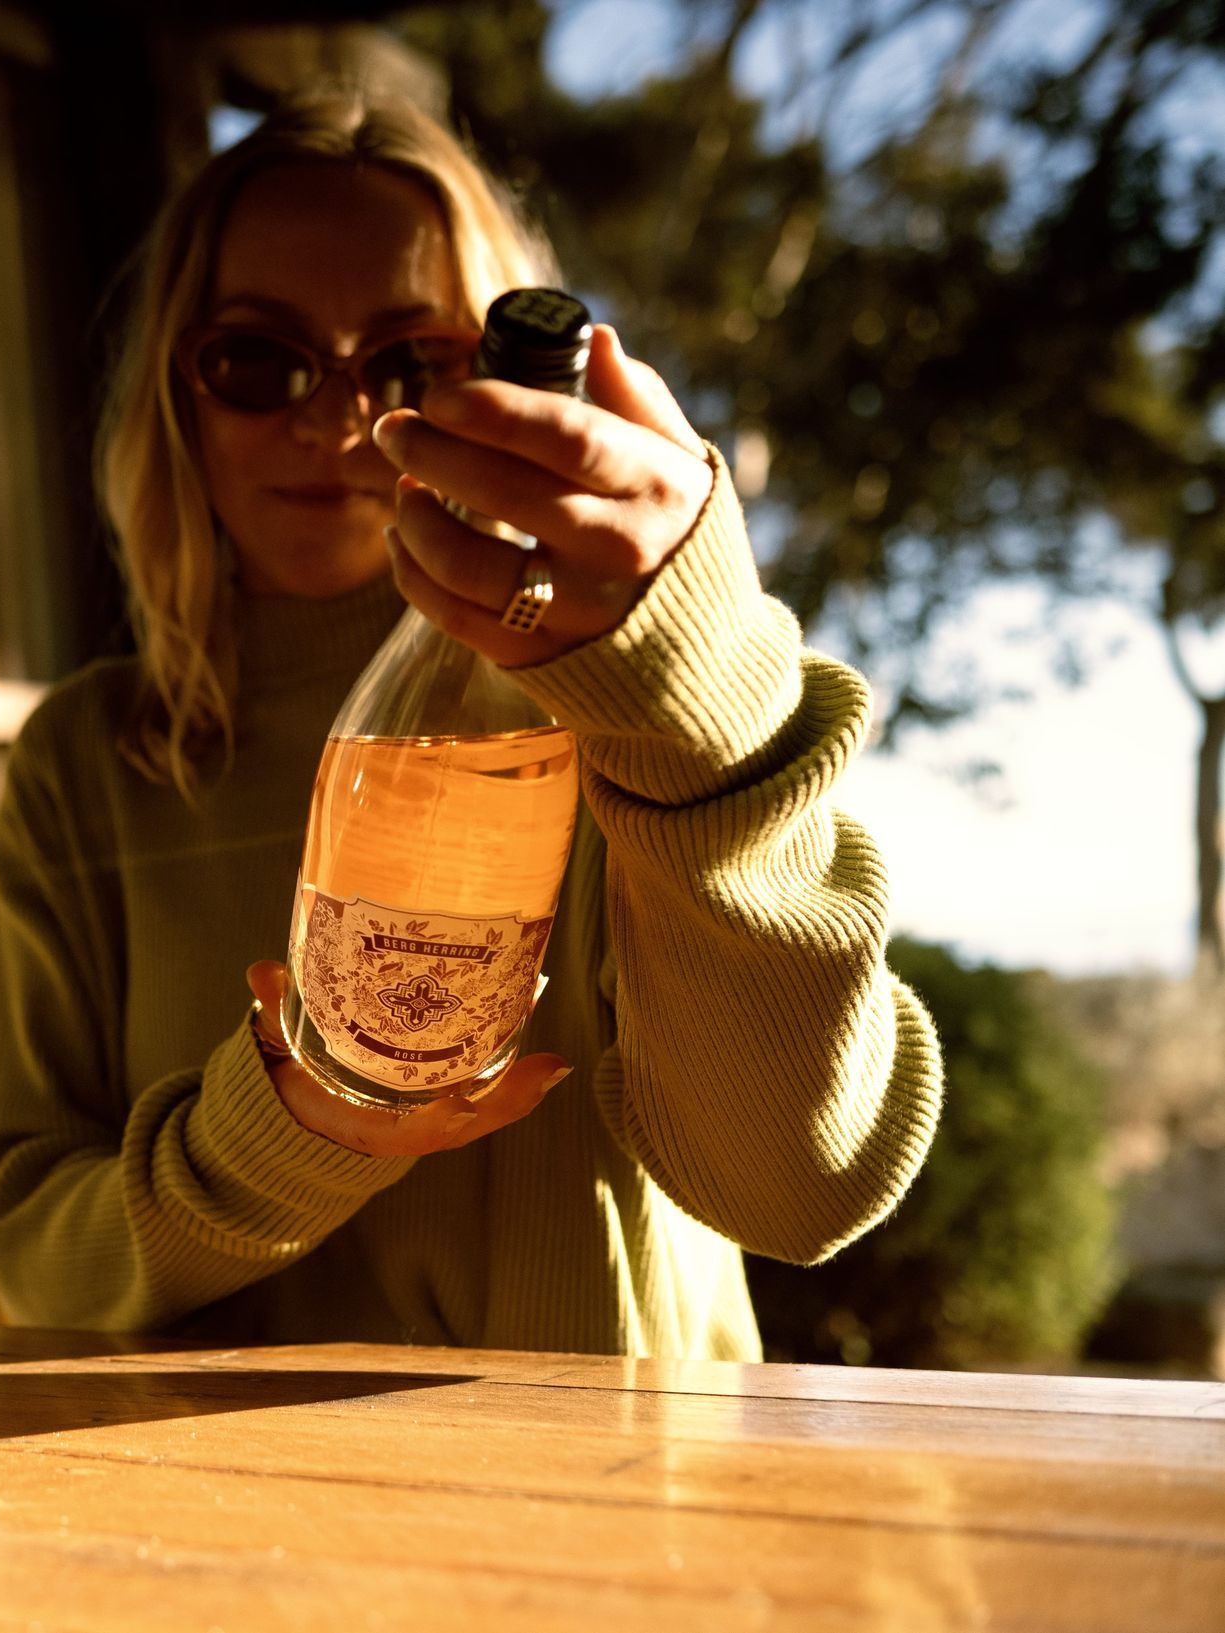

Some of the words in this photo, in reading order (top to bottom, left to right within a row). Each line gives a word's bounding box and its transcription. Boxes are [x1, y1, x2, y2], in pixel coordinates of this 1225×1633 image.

[383, 938, 416, 952] BERG
[424, 945, 480, 957] HERRING
[394, 1050, 423, 1061] ROSÉ
